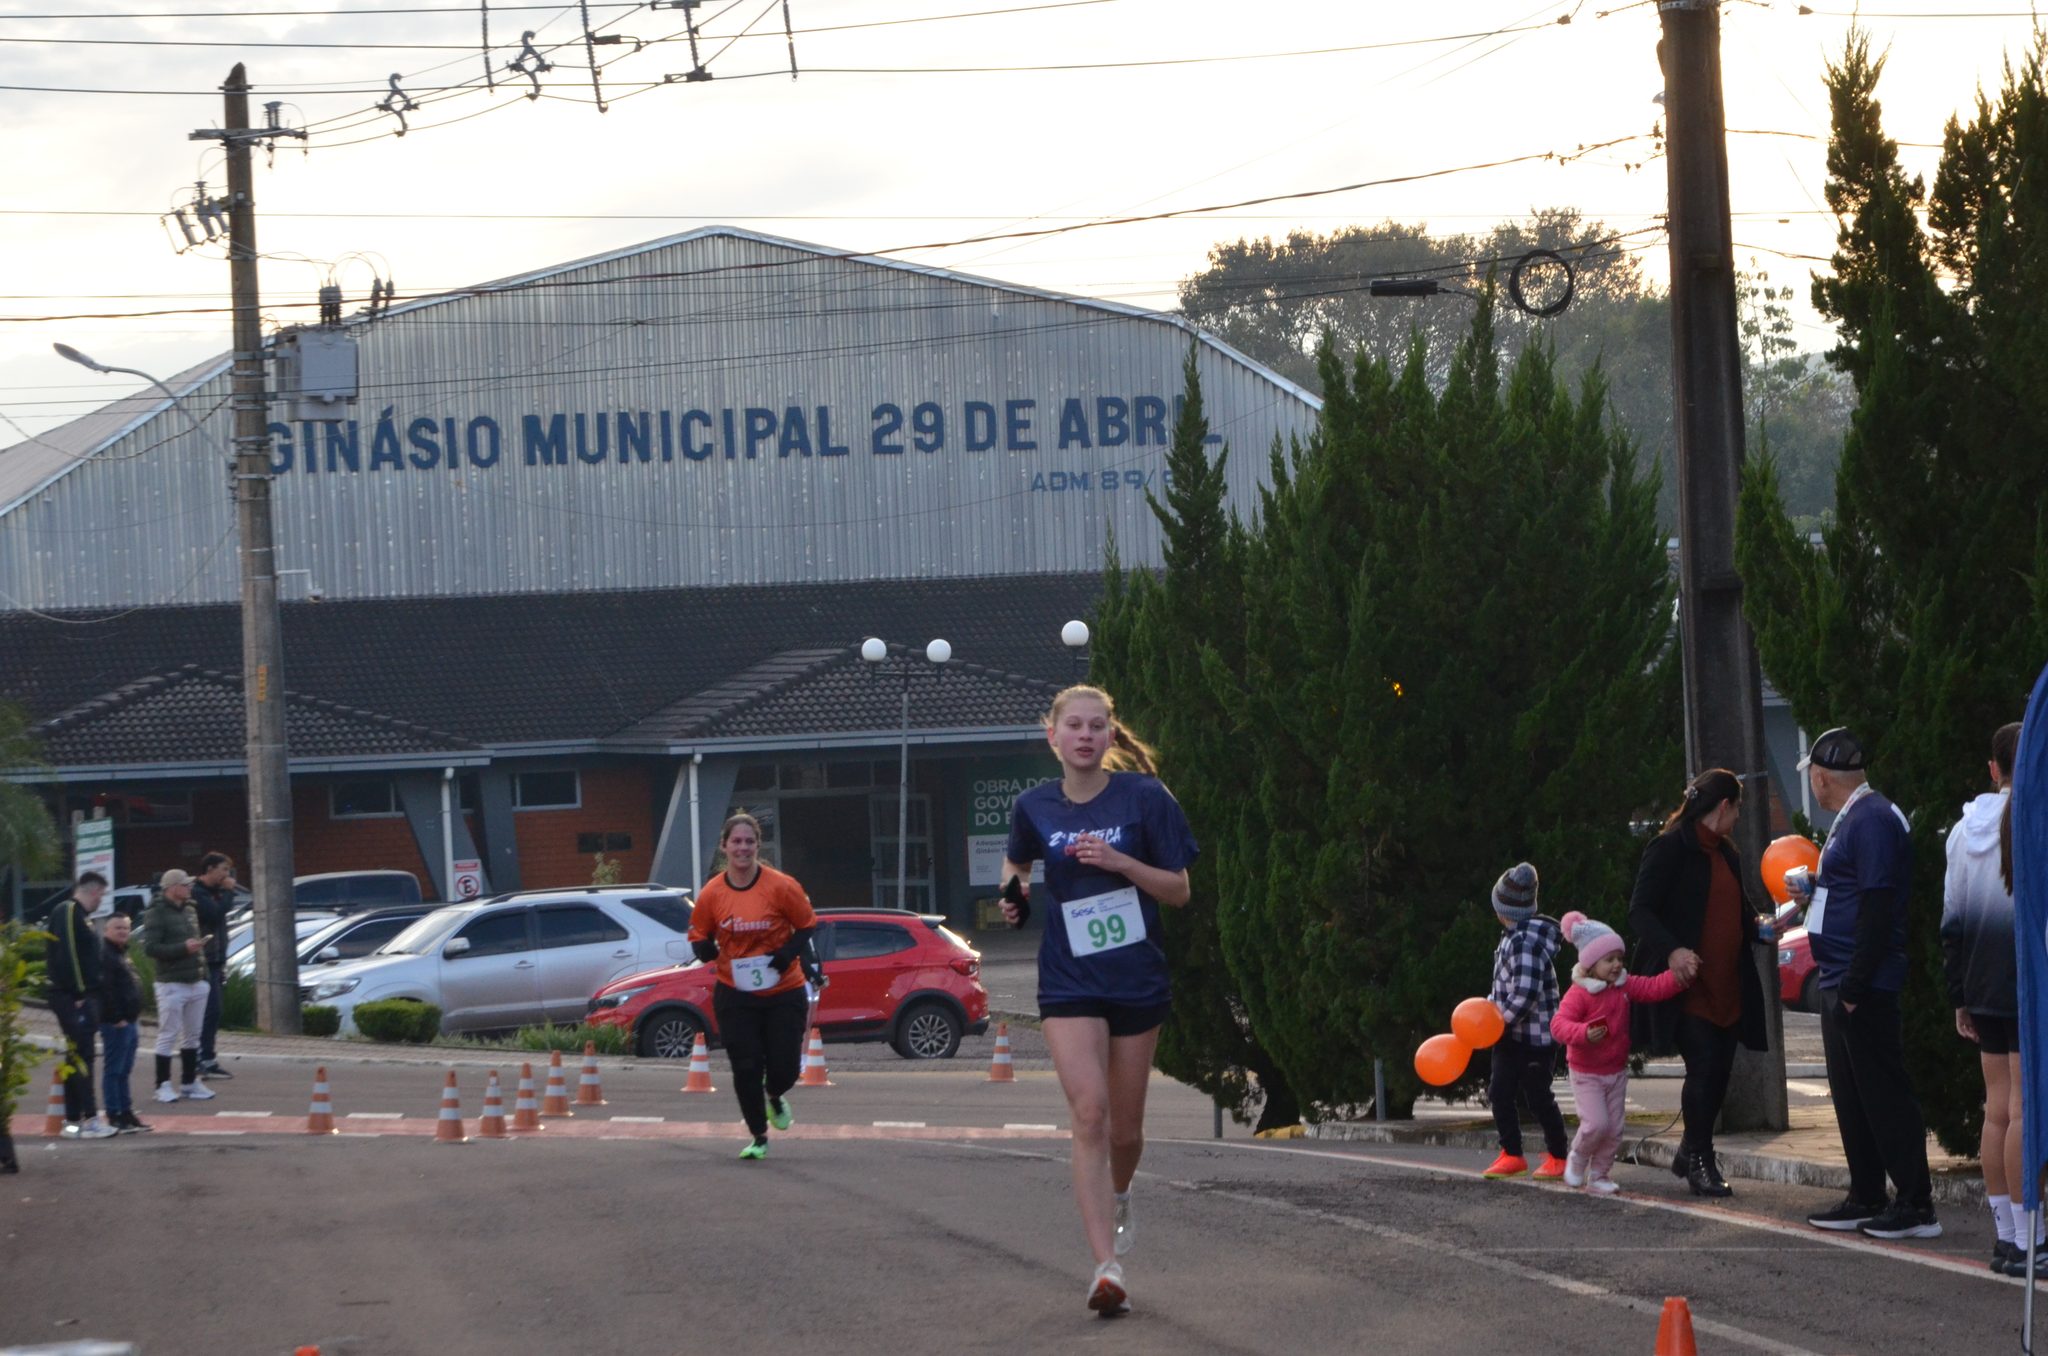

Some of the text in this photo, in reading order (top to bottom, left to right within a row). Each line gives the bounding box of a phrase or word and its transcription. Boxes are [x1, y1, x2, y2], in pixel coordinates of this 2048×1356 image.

[266, 394, 1222, 475] GINÁSIO MUNICIPAL 29 DE ABR
[974, 779, 1022, 794] OBRA
[975, 811, 1001, 827] DO
[1088, 914, 1127, 948] 99
[752, 969, 763, 987] 3
